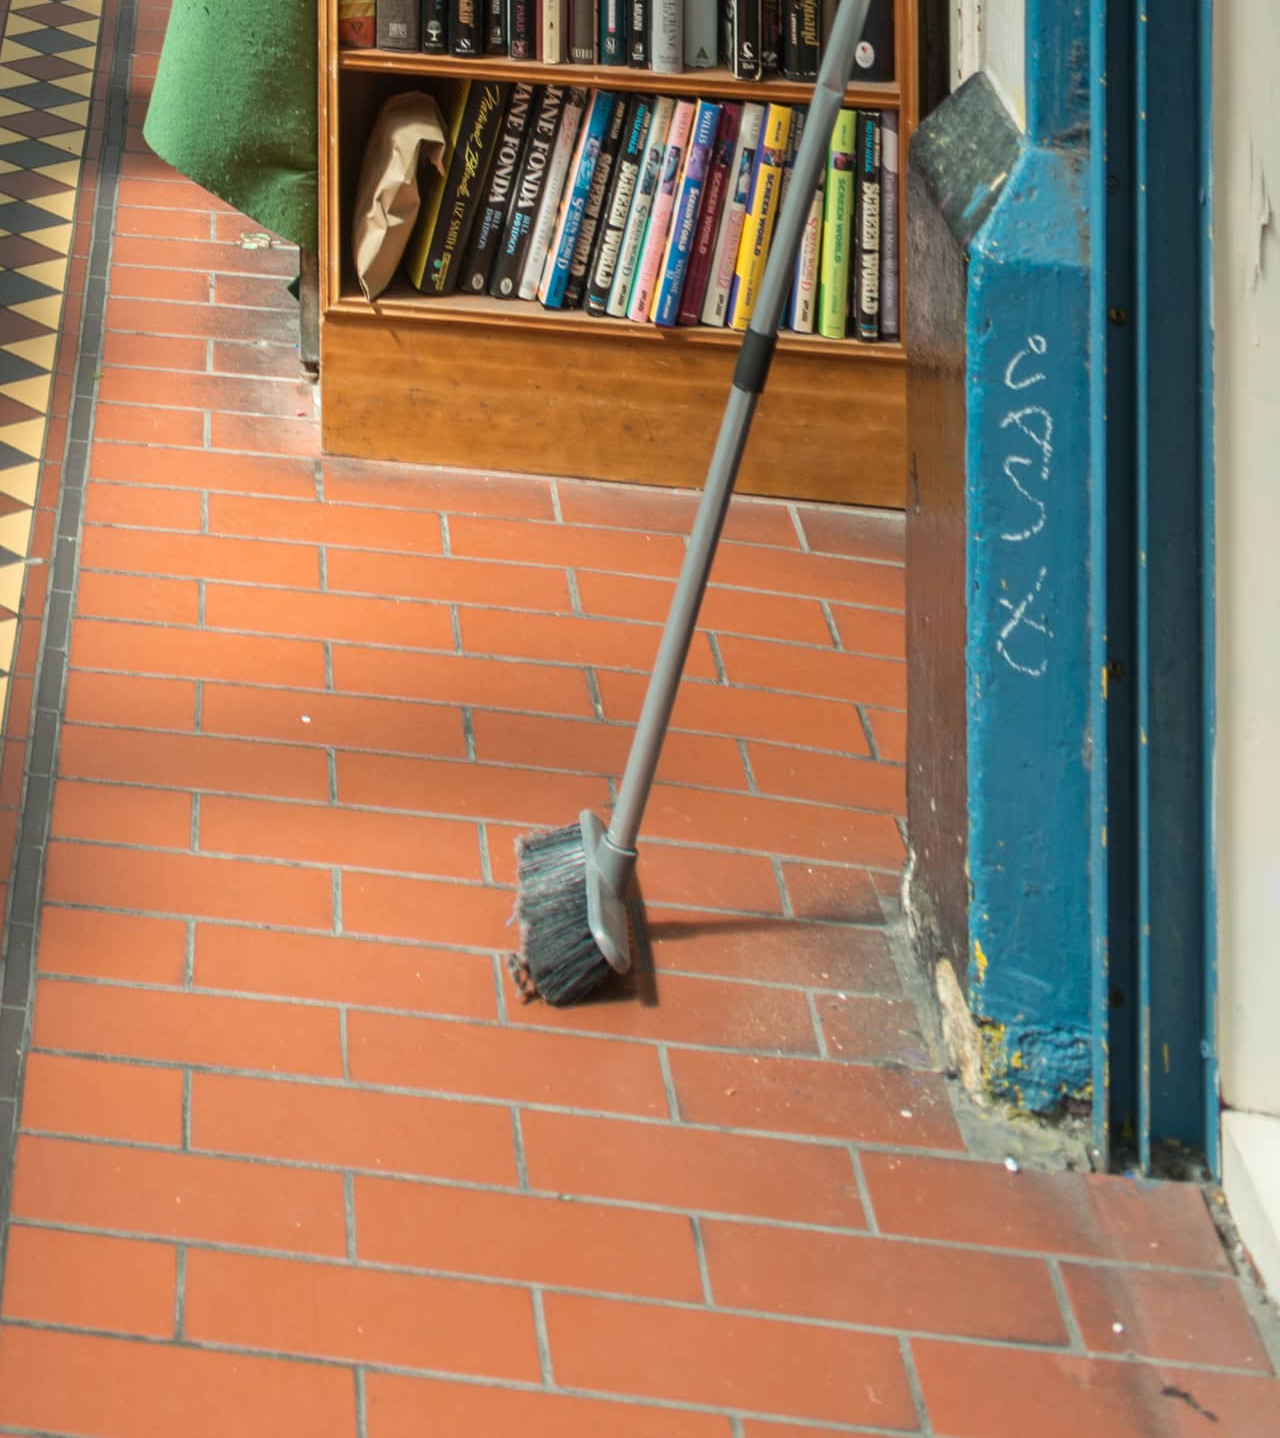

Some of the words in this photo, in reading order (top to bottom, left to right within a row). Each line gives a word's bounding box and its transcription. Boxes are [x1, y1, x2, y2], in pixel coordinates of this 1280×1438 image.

[633, 3, 644, 32] MUNN
[698, 110, 713, 145] WILLIS
[488, 135, 520, 204] FONDA
[518, 139, 548, 209] FONDA
[453, 200, 465, 218] LIZ
[608, 160, 638, 226] SCREEN
[707, 170, 723, 213] SCREEN
[760, 171, 774, 217] SCREEN
[445, 219, 461, 251] SMITH
[699, 214, 713, 255] WORLD
[753, 217, 767, 258] WORLD
[595, 228, 624, 289] WORLD
